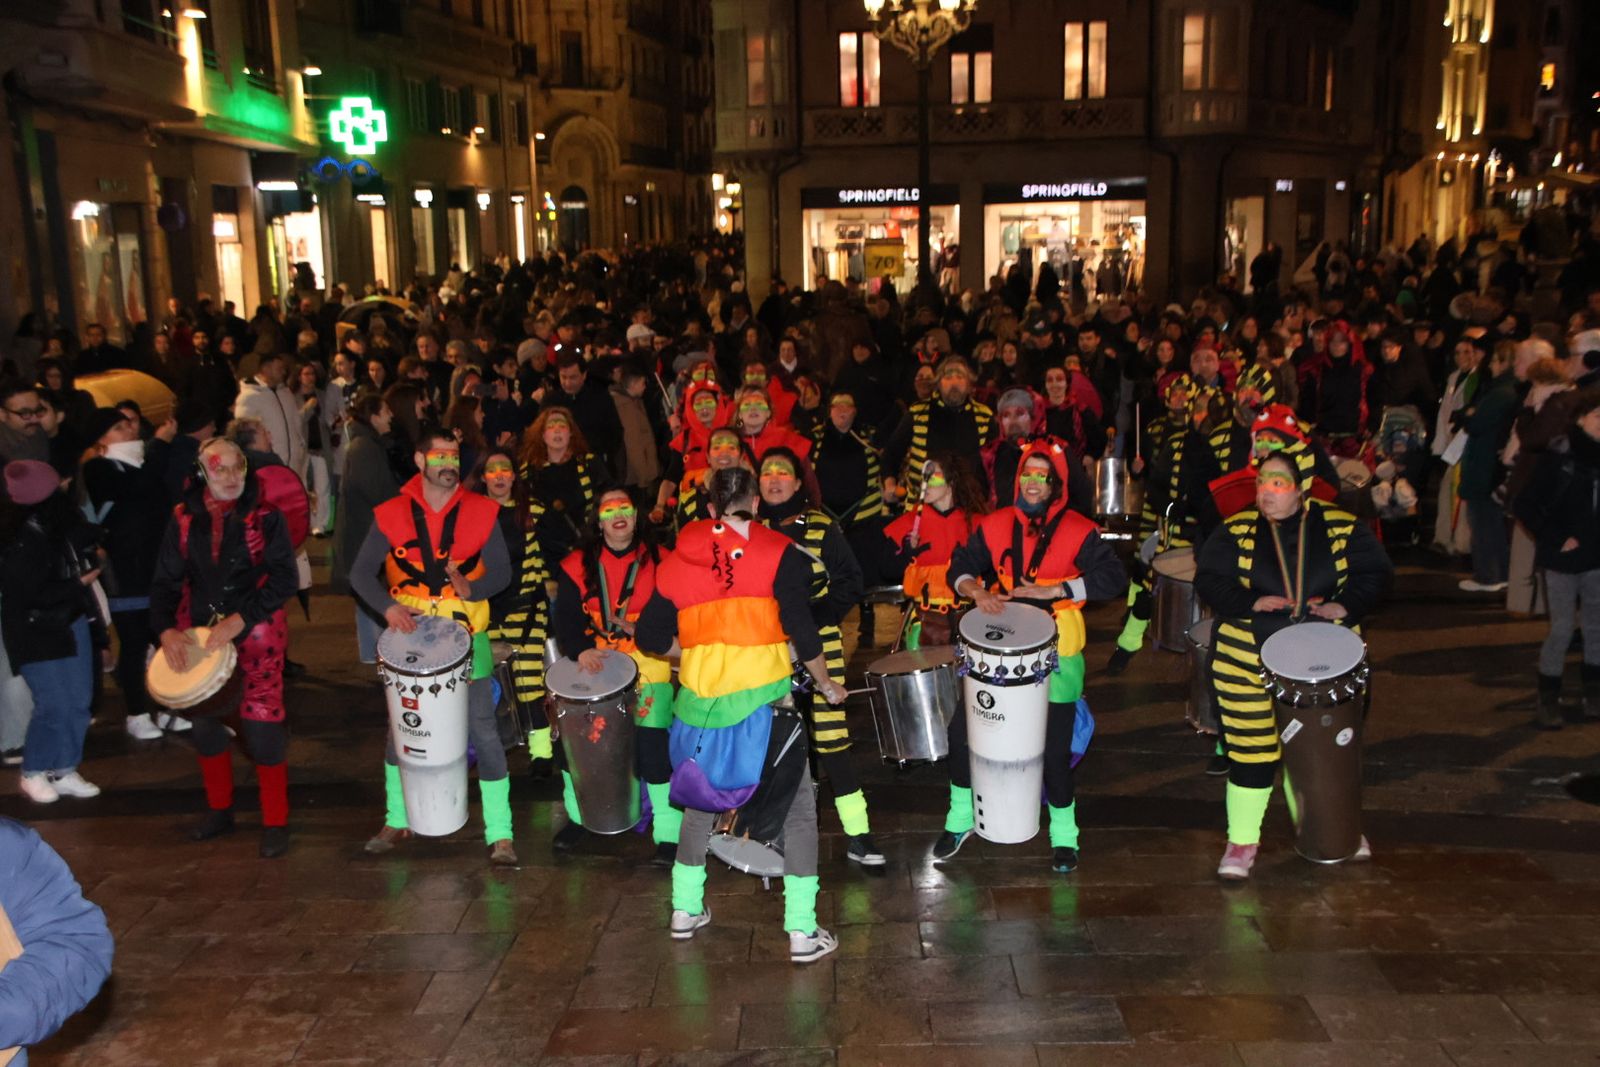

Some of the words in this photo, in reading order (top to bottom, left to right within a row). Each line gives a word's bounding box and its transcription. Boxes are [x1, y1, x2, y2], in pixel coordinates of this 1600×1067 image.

[839, 188, 919, 202] SPRINGFIELD
[1022, 182, 1107, 198] SPRINGFIELD
[972, 705, 1005, 721] TIMBRA
[398, 723, 431, 737] TIMBRA
